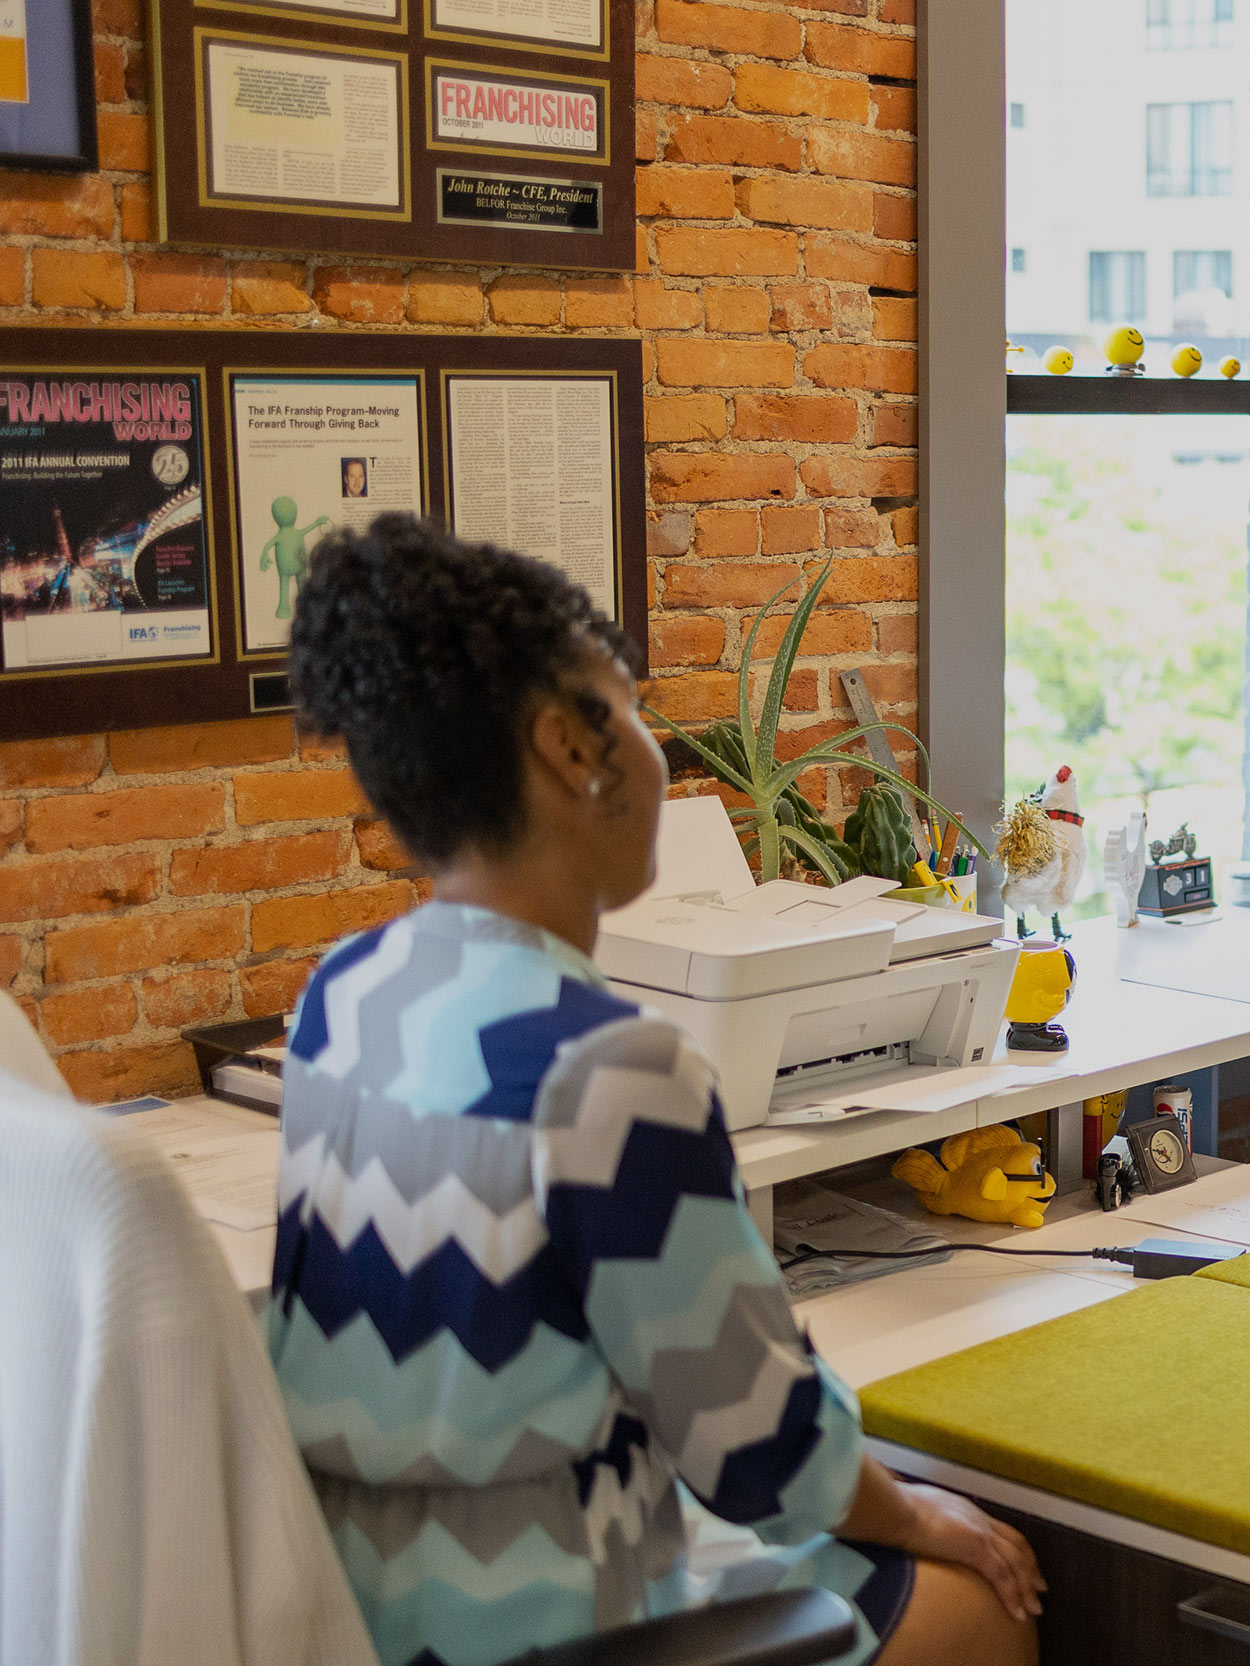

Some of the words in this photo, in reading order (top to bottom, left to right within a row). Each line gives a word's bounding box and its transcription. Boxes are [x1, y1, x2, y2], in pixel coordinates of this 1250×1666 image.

[441, 82, 595, 131] FRANCHISING
[443, 118, 471, 129] OCTOBER
[472, 121, 484, 129] 2011
[534, 126, 595, 148] WORLD
[448, 179, 474, 193] John
[476, 181, 511, 197] Rotche
[521, 186, 547, 201] CFE,
[550, 188, 594, 203] President
[476, 198, 505, 209] BELFOR
[506, 200, 535, 212] Franchise
[535, 203, 556, 215] Group
[556, 205, 568, 214] Inc.
[506, 212, 528, 221] October
[248, 406, 265, 415] The
[268, 406, 282, 415] IFA
[285, 406, 323, 417] Franship
[113, 421, 193, 441] WORLD
[248, 419, 286, 429] Forward
[289, 419, 326, 431] Through
[328, 419, 356, 430] Giving
[358, 419, 380, 429] Back
[30, 427, 46, 437] 2011
[1, 457, 23, 468] 2011
[24, 456, 39, 467] IFA
[40, 455, 76, 467] ANNUAL
[76, 455, 130, 467] CONVENTION
[130, 628, 147, 639] IFA
[1177, 1107, 1189, 1145] PSI
